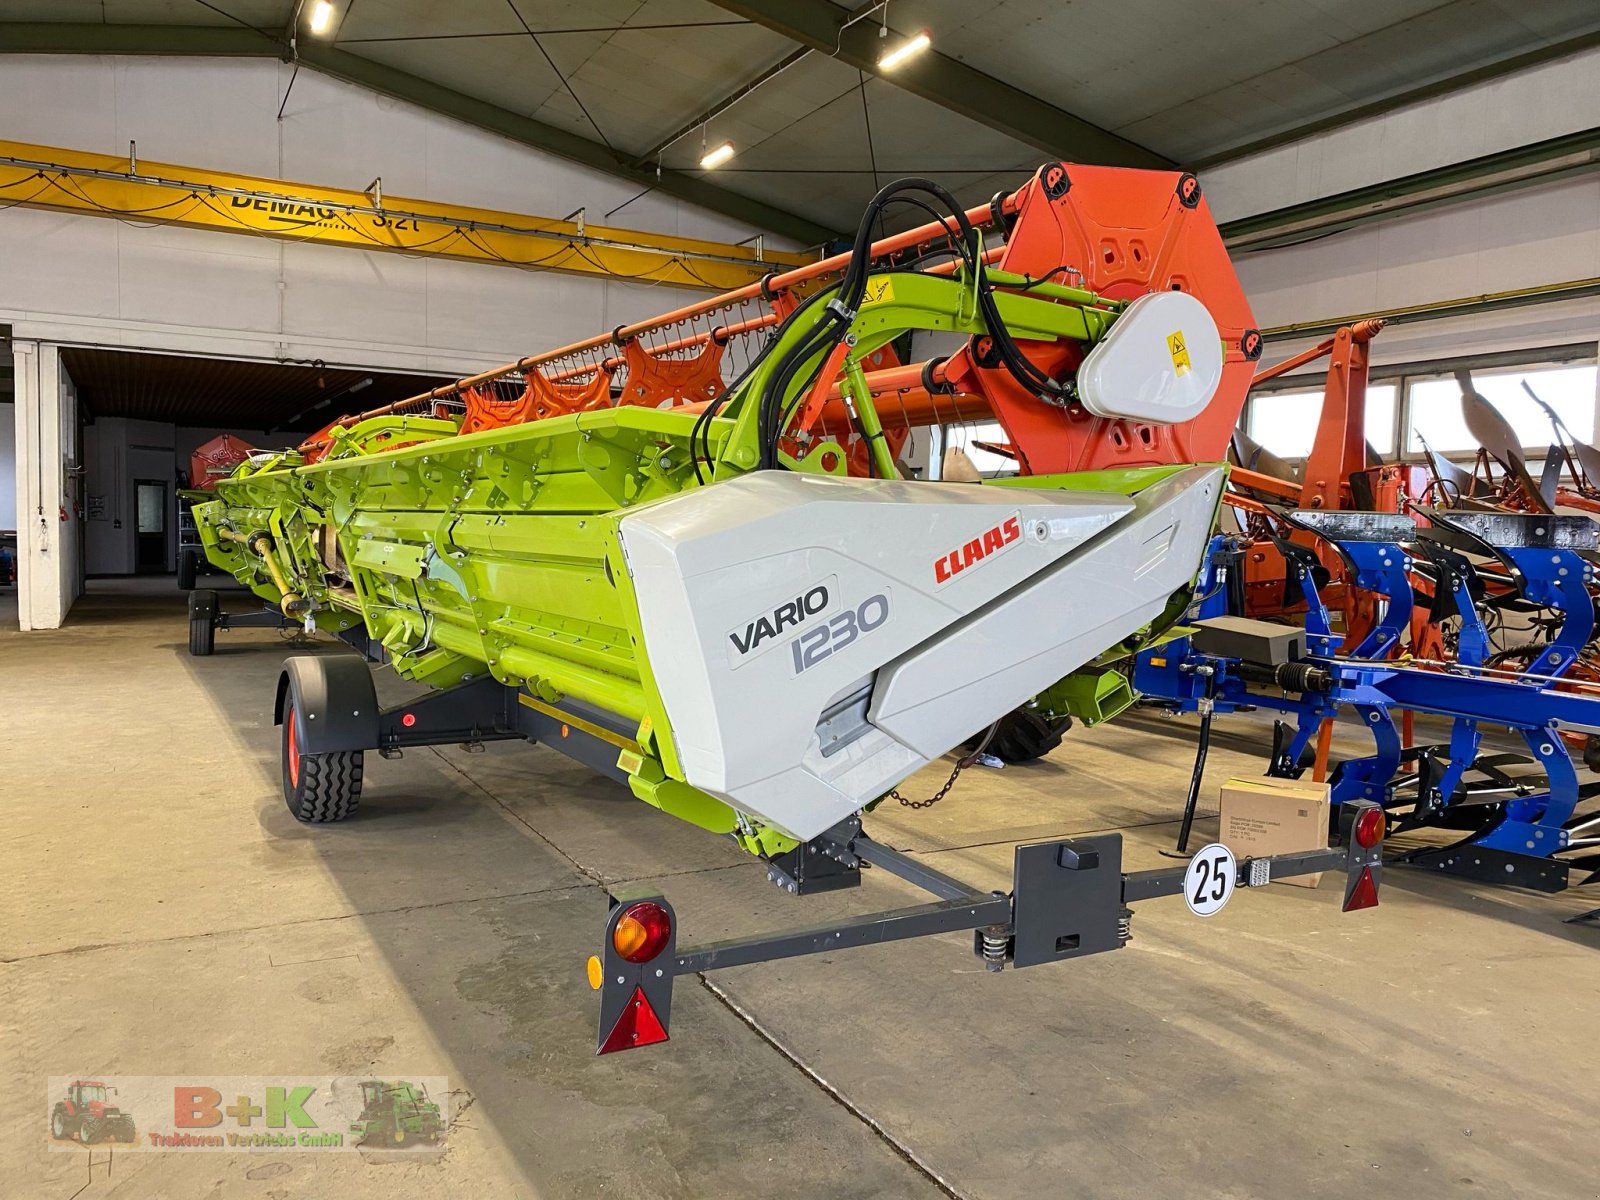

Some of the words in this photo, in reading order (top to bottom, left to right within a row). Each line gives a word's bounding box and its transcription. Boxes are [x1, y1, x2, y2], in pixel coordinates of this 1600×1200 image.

[231, 188, 335, 219] DEMAG
[934, 516, 1021, 585] CLAAS
[729, 585, 829, 655] VARIO
[790, 594, 889, 674] 1230
[1193, 856, 1227, 904] 25
